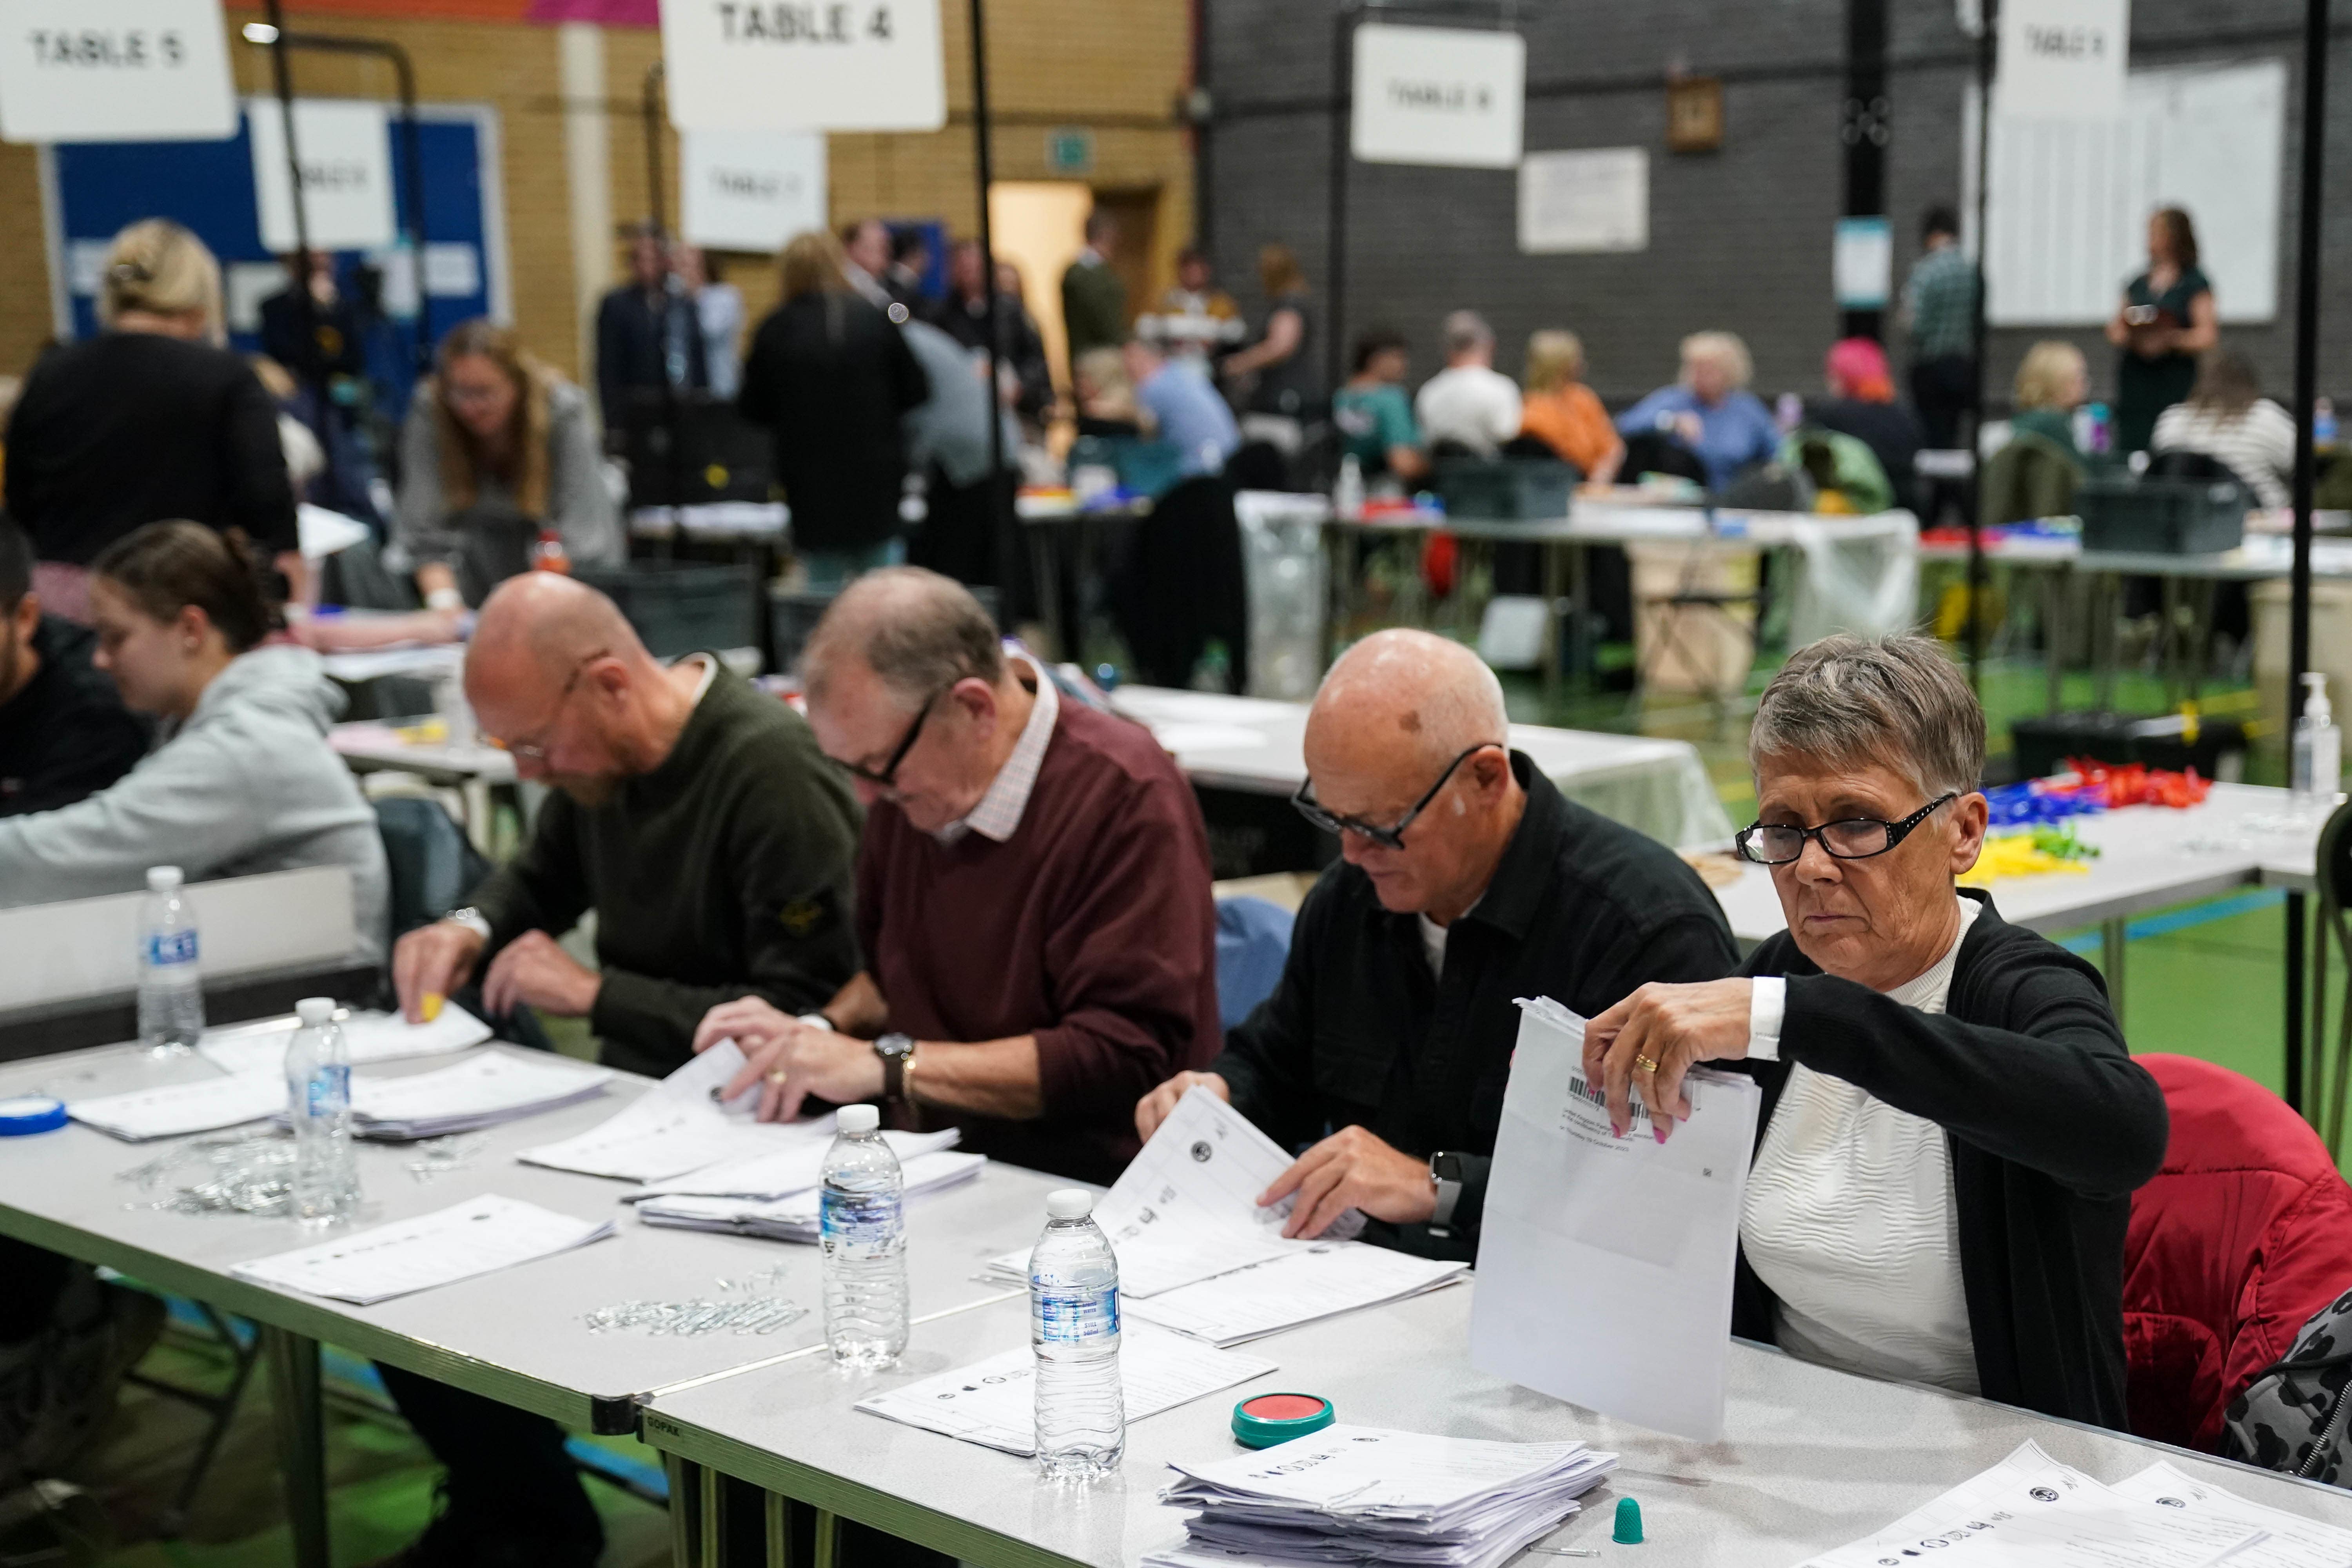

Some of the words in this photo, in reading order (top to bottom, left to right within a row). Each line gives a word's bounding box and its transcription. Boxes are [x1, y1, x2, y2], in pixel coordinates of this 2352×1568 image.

[715, 2, 855, 44] TABLE
[864, 3, 894, 42] 4
[29, 28, 147, 68] TABLE
[160, 29, 187, 68] 5
